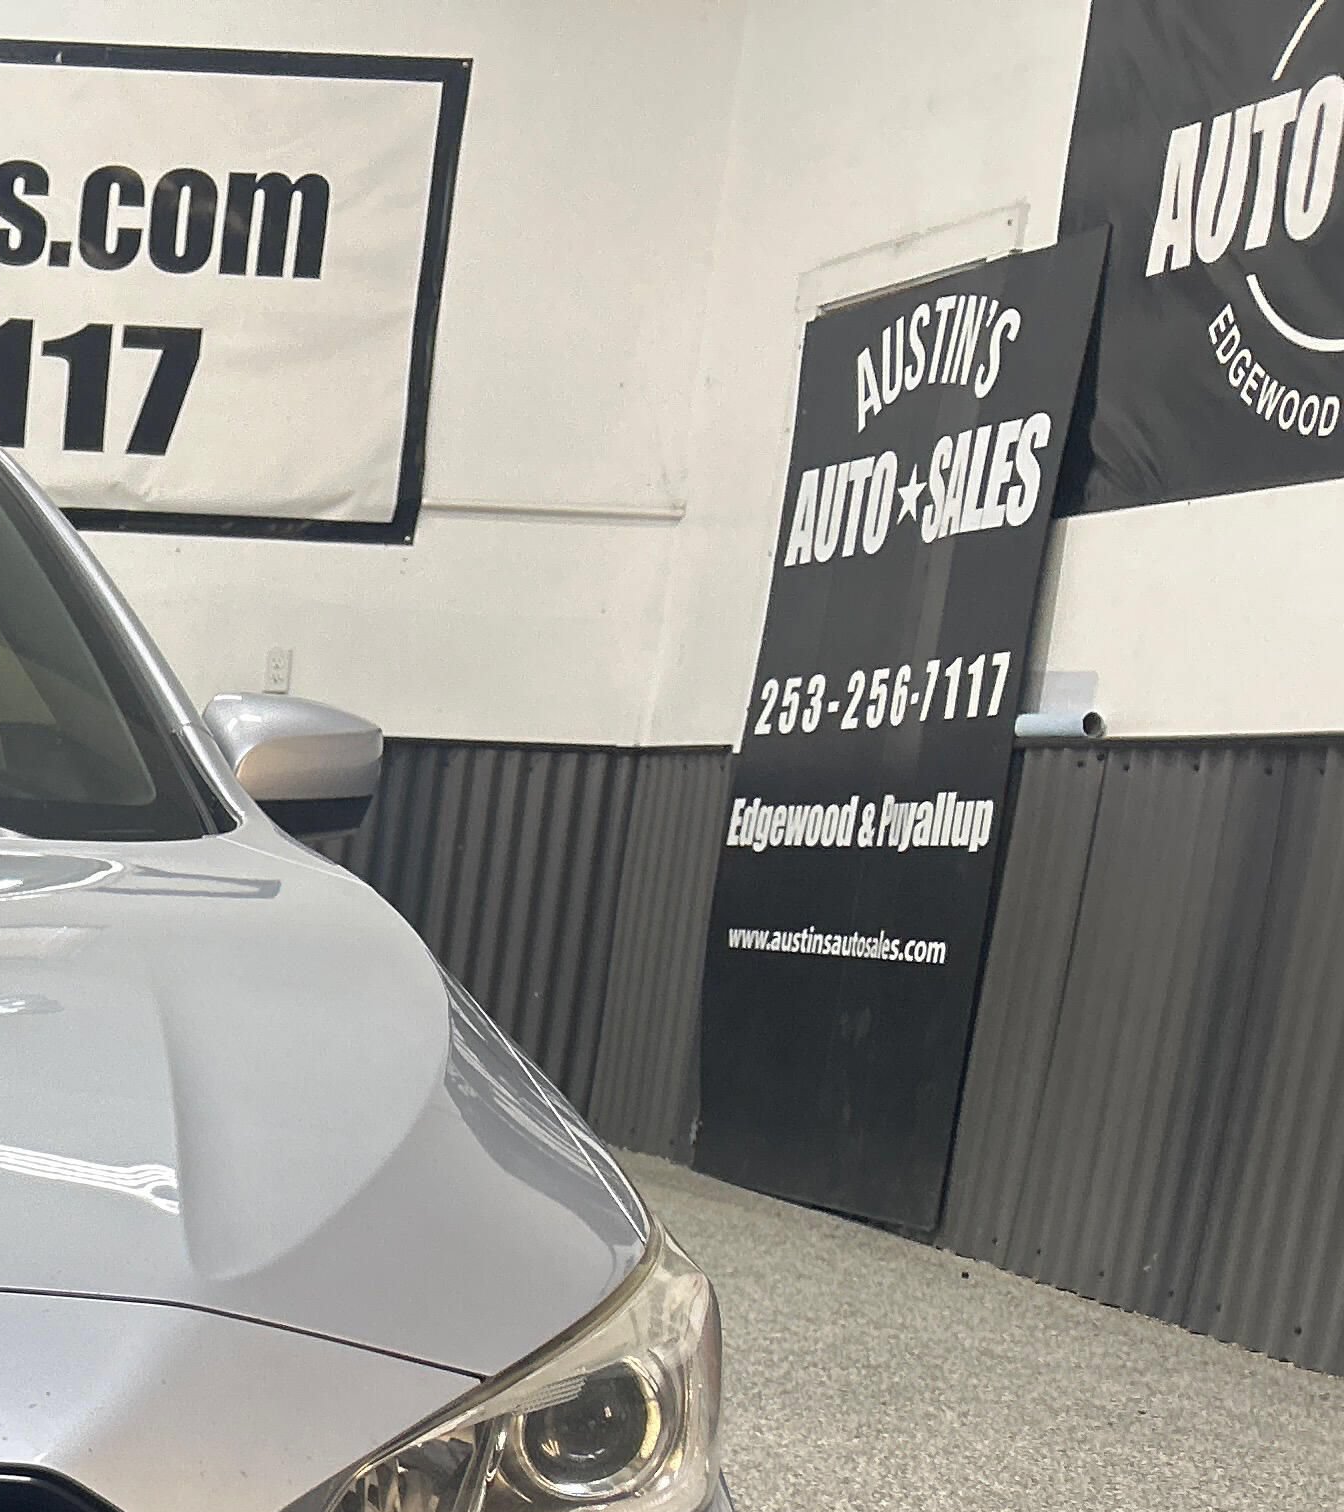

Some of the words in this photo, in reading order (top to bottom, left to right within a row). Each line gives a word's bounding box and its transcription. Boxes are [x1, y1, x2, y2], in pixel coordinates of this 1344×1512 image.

[1145, 75, 1344, 277] AUTO
[857, 295, 1021, 433] AUSTIN'S
[1209, 303, 1340, 437] EDGEWOOD
[784, 450, 898, 567] AUTO
[921, 412, 1051, 543] SALES
[754, 651, 1011, 735] 253-256-7117
[726, 795, 859, 852] Edgewood
[858, 802, 875, 847] &
[877, 792, 993, 852] Puyallup
[728, 926, 946, 964] www.austinsautosales.com
